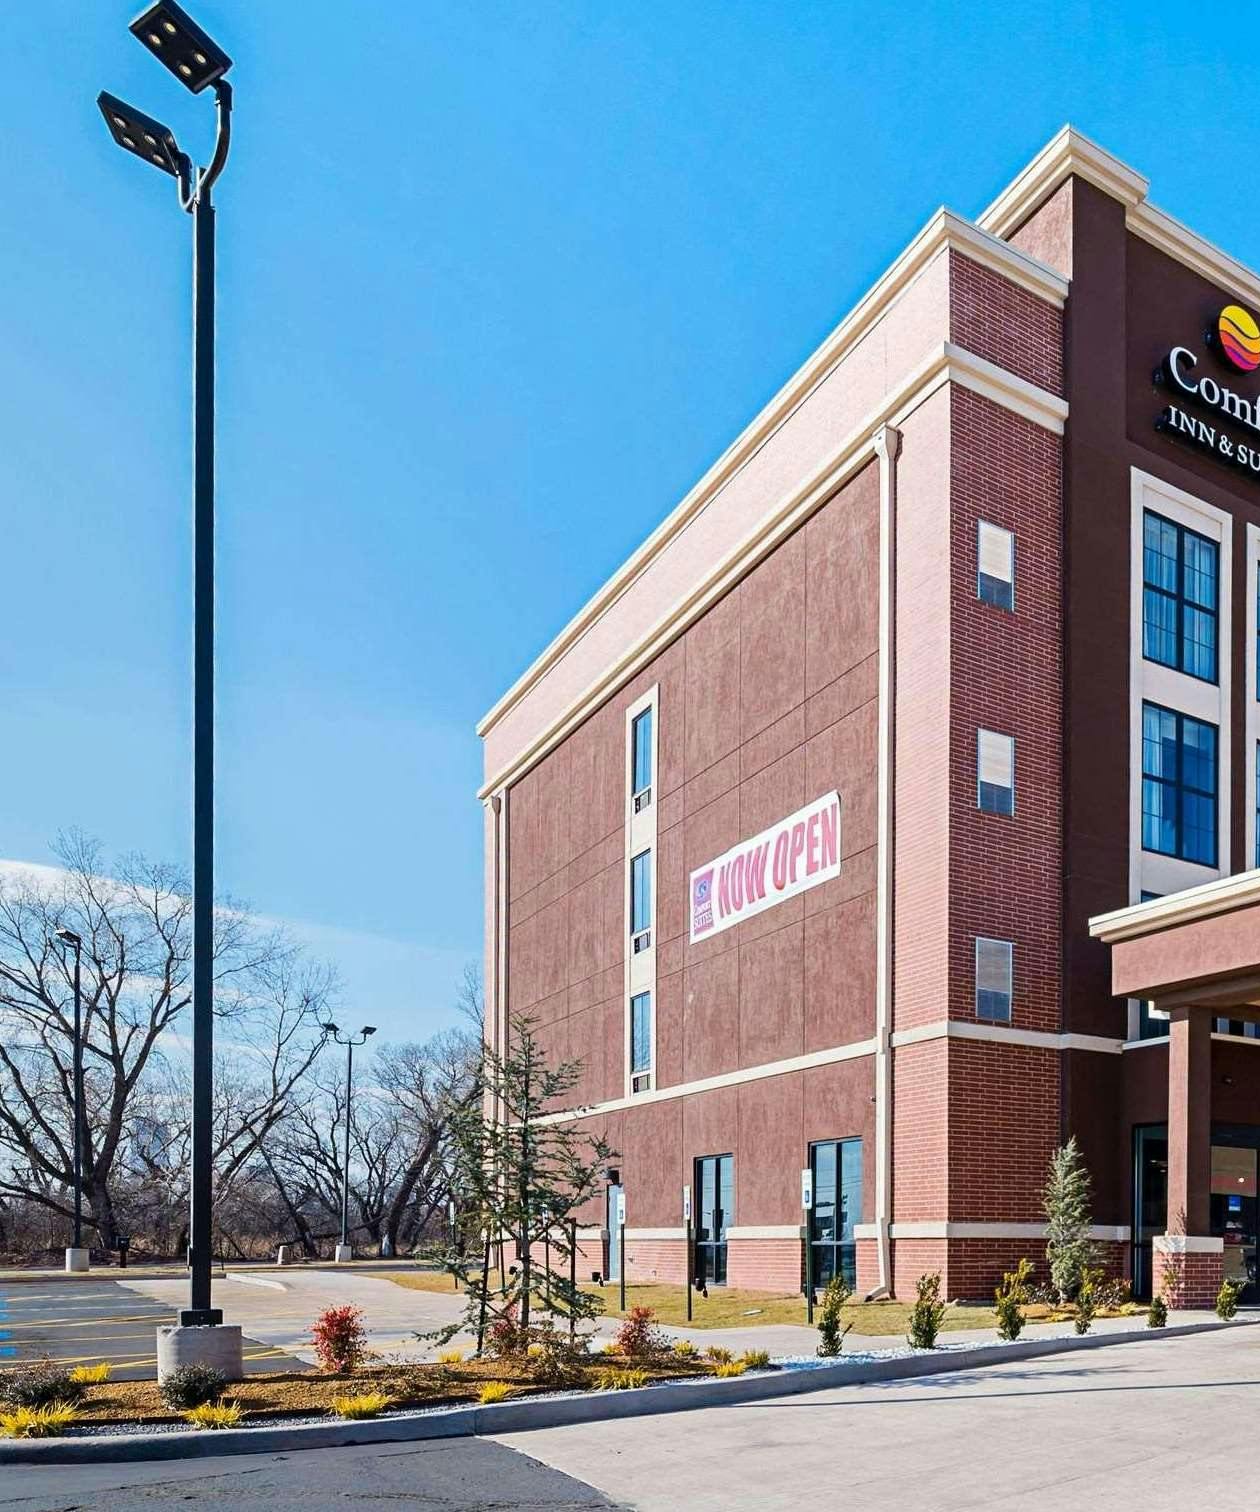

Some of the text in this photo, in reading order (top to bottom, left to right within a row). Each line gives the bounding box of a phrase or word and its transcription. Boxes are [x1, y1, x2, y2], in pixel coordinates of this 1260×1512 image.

[1168, 405, 1216, 448] INN
[1219, 434, 1234, 457] &
[718, 803, 838, 919] NOW OPEN
